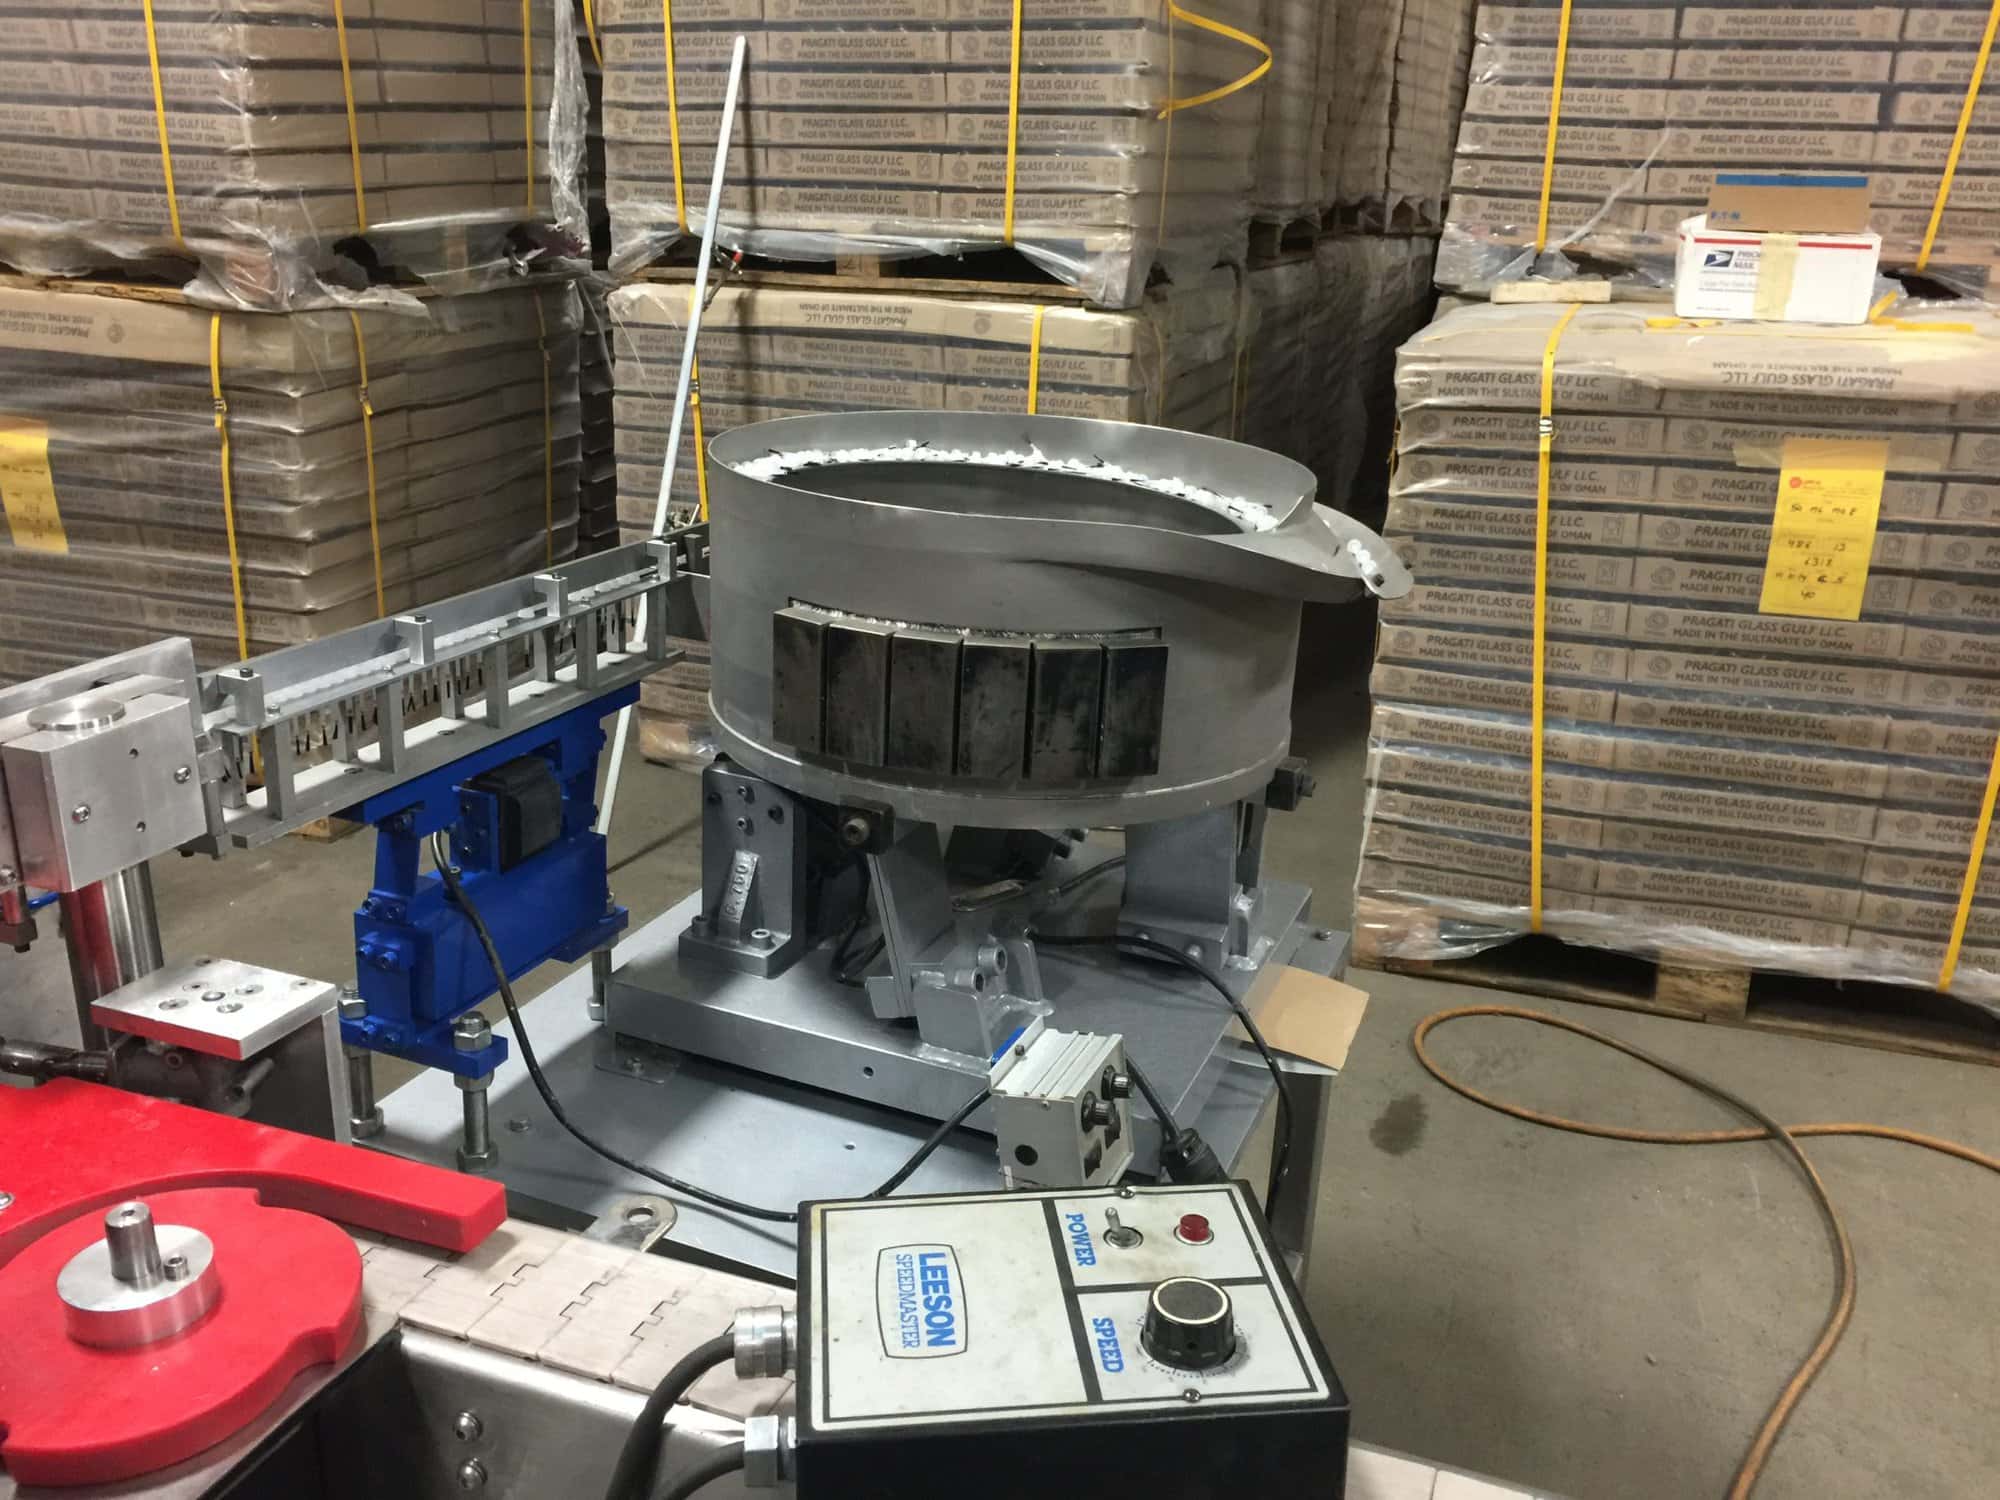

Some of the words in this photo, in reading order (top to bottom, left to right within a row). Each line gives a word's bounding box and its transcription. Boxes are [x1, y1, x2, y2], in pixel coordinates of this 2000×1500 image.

[801, 38, 835, 47] PRAGATI
[838, 38, 863, 47] GLASS
[866, 38, 888, 47] GULF
[1025, 80, 1051, 89] GLASS
[1054, 80, 1079, 89] GULF
[1706, 96, 1747, 105] PRAGATI
[1750, 97, 1781, 106] GLASS
[1784, 98, 1811, 107] GULF
[1701, 135, 1741, 143] PRAGATI
[1744, 135, 1775, 144] GLASS
[1777, 136, 1805, 145] GULF
[800, 153, 834, 162] PRAGATI
[836, 155, 860, 163] GLASS
[863, 156, 884, 164] GULF
[1446, 372, 1496, 384] PRAGATI
[1499, 374, 1536, 386] GLASS
[1752, 373, 1788, 385] GULF
[1792, 374, 1833, 386] GLASS
[1838, 376, 1895, 389] PRAGATI
[1438, 388, 1466, 397] MADE
[1468, 388, 1479, 397] IN
[1483, 389, 1499, 398] THE
[1562, 391, 1573, 400] OF
[1577, 392, 1609, 401] OMAN
[1710, 401, 1740, 410] MADE
[1745, 402, 1755, 411] IN
[1759, 403, 1778, 411] THE
[1846, 406, 1860, 414] OF
[1864, 406, 1899, 416] OMAN
[1712, 478, 1764, 492] PRAGATI
[1433, 509, 1483, 520] PRAGATI
[1485, 511, 1521, 523] GLASS
[1426, 522, 1451, 531] MADE
[1455, 524, 1465, 532] IN
[1469, 524, 1485, 534] THE
[1562, 530, 1592, 540] OMAN
[1694, 526, 1750, 539] PRAGATI
[1686, 539, 1714, 549] MADE
[1426, 591, 1475, 604] PRAGATI
[1477, 595, 1512, 608] GLASS
[1682, 615, 1736, 629] PRAGATI
[1738, 620, 1777, 632] GLASS
[1781, 623, 1814, 635] GULF
[1674, 629, 1701, 638] MADE
[1705, 631, 1716, 640] IN
[1720, 632, 1739, 641] THE
[1742, 633, 1801, 646] SULTANATE
[1805, 638, 1817, 648] OF
[1820, 639, 1852, 650] OMAN
[1685, 660, 1737, 674] PRAGATI
[1740, 664, 1779, 677] GLASS
[1782, 668, 1816, 680] GULF
[1676, 673, 1704, 683] MADE
[1707, 675, 1718, 684] IN
[1721, 676, 1740, 686] THE
[1743, 678, 1802, 691] SULTANATE
[1805, 683, 1818, 692] OF
[1821, 684, 1855, 696] OMAN
[1669, 706, 1721, 720] PRAGATI
[1724, 710, 1762, 723] GLASS
[1766, 714, 1800, 727] GULF
[1660, 718, 1688, 729] MADE
[1691, 721, 1702, 730] IN
[1705, 722, 1724, 732] THE
[1788, 729, 1801, 739] OF
[1805, 731, 1836, 742] OMAN
[1667, 750, 1718, 764] PRAGATI
[1721, 755, 1760, 768] GLASS
[1764, 758, 1798, 772] GULF
[1658, 761, 1683, 772] MADE
[1689, 764, 1700, 773] IN
[1704, 765, 1723, 776] THE
[1785, 773, 1798, 783] OF
[1801, 775, 1833, 787] OMAN
[1660, 791, 1711, 806] PRAGATI
[1715, 797, 1752, 810] GLASS
[1756, 801, 1789, 814] GULF
[1651, 872, 1700, 886] PRAGATI
[1704, 878, 1741, 891] GLASS
[1744, 882, 1777, 894] GULF
[1065, 1213, 1096, 1267] POWER
[896, 1253, 915, 1349] SPEEDMASTER
[918, 1252, 956, 1347] LEESON
[1092, 1317, 1124, 1373] SPEED
